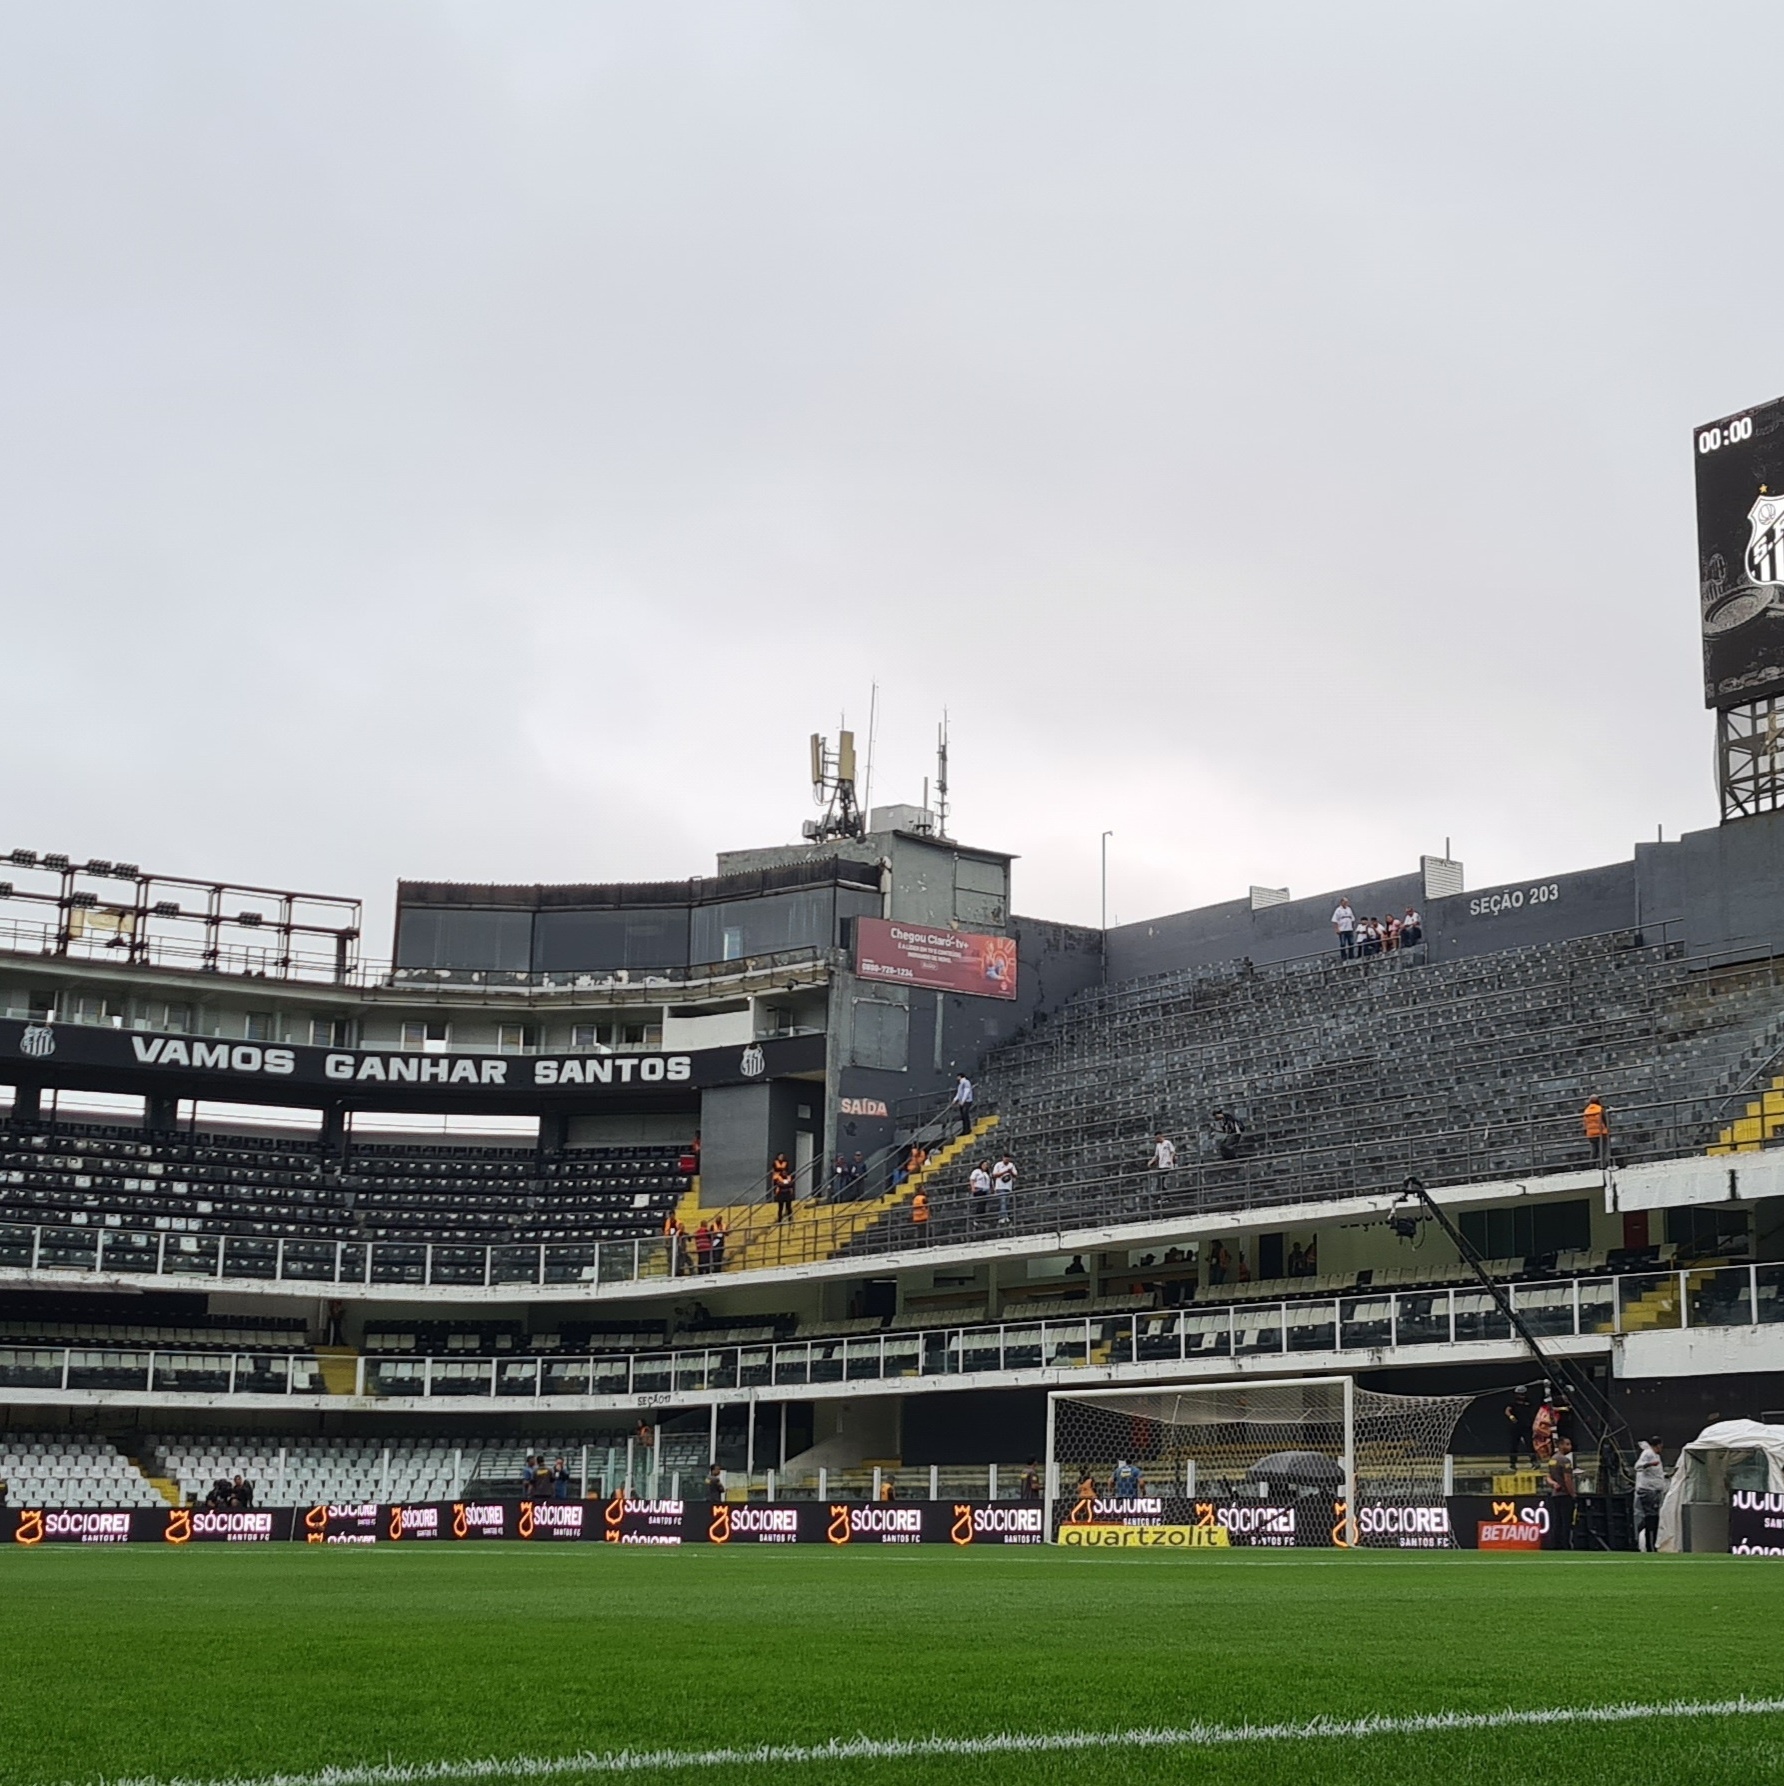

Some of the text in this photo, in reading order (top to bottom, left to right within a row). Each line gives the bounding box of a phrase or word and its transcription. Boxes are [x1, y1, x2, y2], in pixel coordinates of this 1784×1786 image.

[1699, 417, 1752, 453] 00:00
[1470, 884, 1559, 916] SEÇÃO 203
[890, 928, 926, 943] Chegou
[131, 1036, 691, 1084] VAMOS GANHAR SANTOS
[841, 1098, 888, 1117] SAÍDA
[46, 1510, 130, 1533] SÓCIOREI
[193, 1510, 272, 1532] SÓCIOREI
[402, 1506, 437, 1528] SÓCIOREI
[465, 1502, 503, 1525] SÓCIOREI
[534, 1501, 582, 1525] SÓCIOREI
[731, 1505, 797, 1531] SÓCIOREI
[851, 1504, 921, 1531] SÓCIOREI
[974, 1504, 1042, 1531] SÓCIOREI
[1217, 1502, 1295, 1532] SÓCIOREI
[1360, 1502, 1448, 1532] SÓCIOREI
[759, 1533, 786, 1542] SANTOS
[882, 1534, 909, 1543] SANTOS
[1004, 1534, 1042, 1543] SANTOS FC
[1481, 1525, 1540, 1541] BETANO
